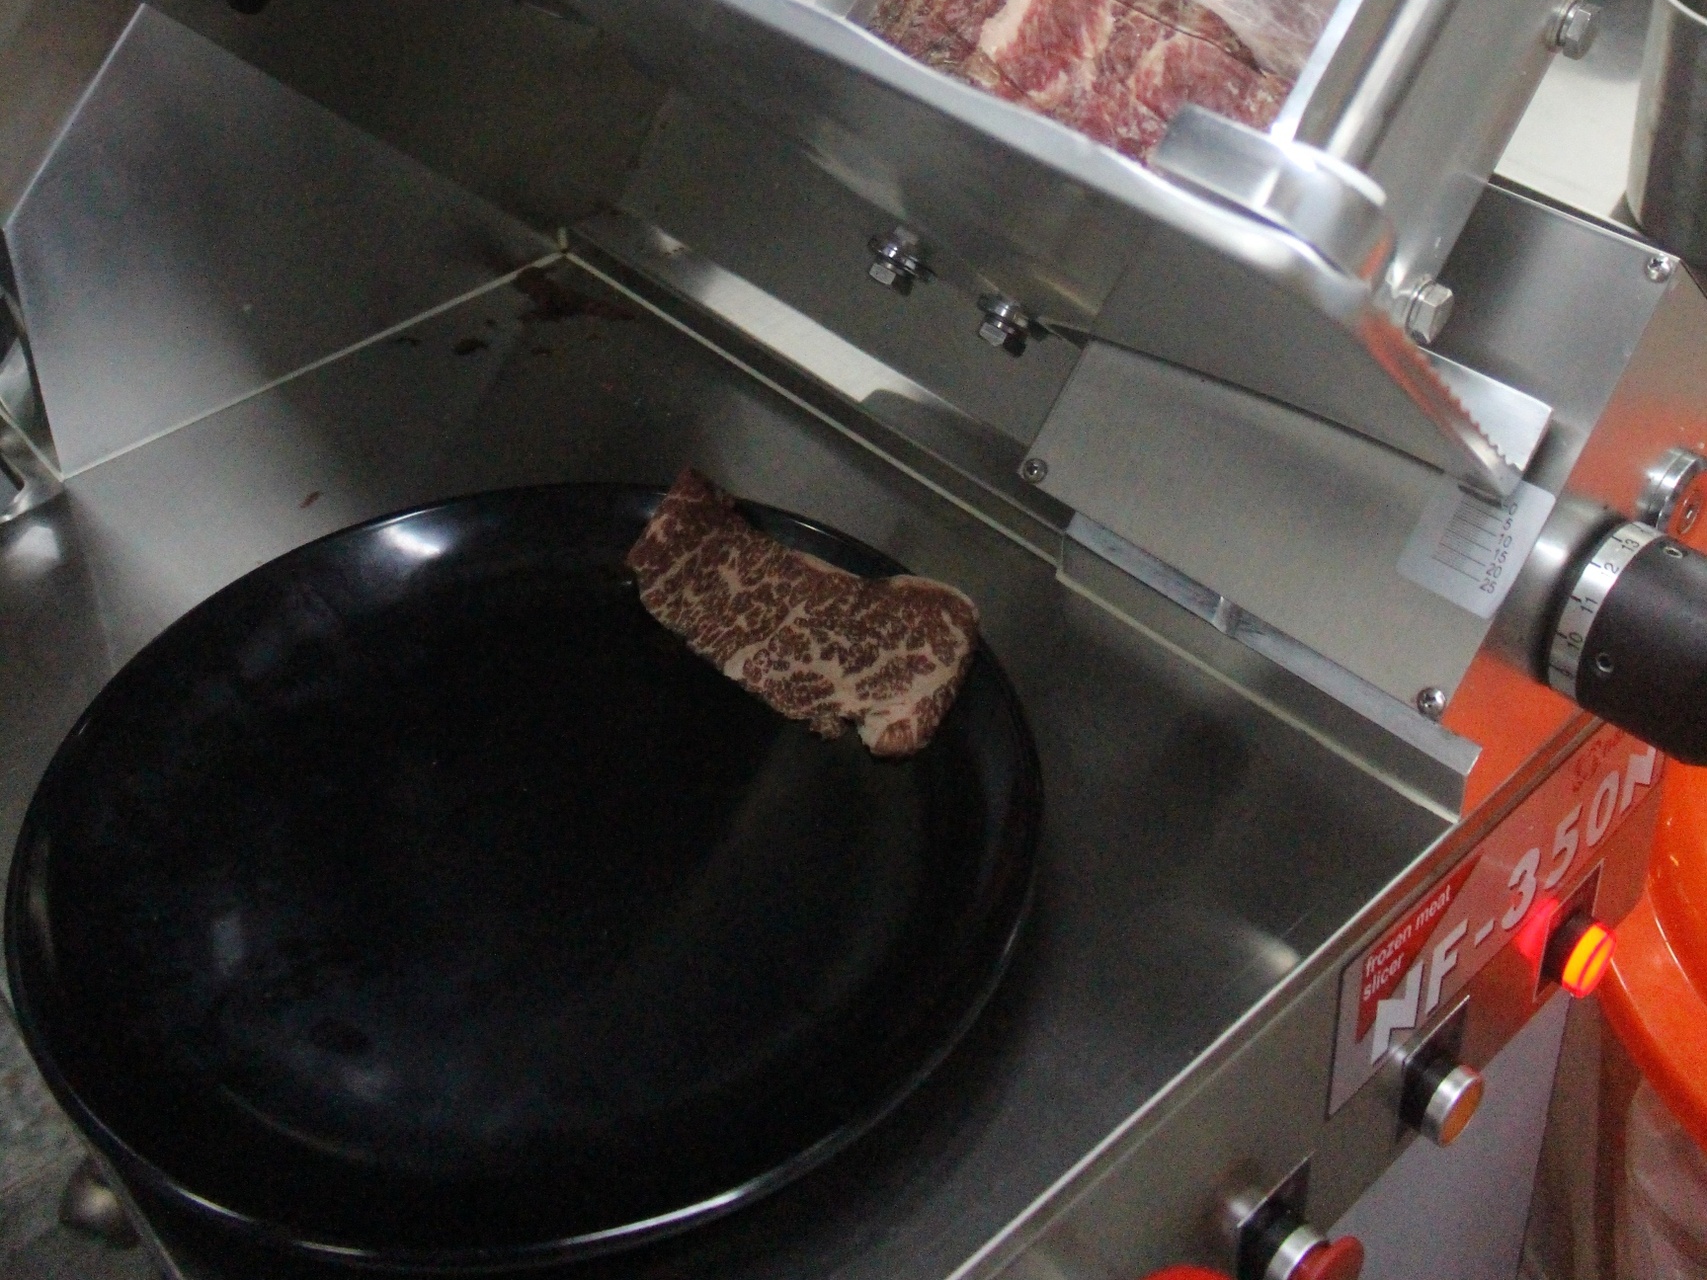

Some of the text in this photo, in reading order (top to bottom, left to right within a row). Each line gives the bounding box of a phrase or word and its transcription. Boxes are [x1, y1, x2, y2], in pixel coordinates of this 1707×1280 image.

[1502, 518, 1513, 531] 5
[1621, 538, 1641, 552] 13
[1494, 549, 1508, 564] 15
[1486, 563, 1502, 579] 20
[1480, 578, 1497, 594] 25
[1580, 597, 1598, 614] 11
[1567, 631, 1583, 650] 10
[1365, 884, 1451, 978] frozen meat
[1363, 952, 1405, 1002] slicer
